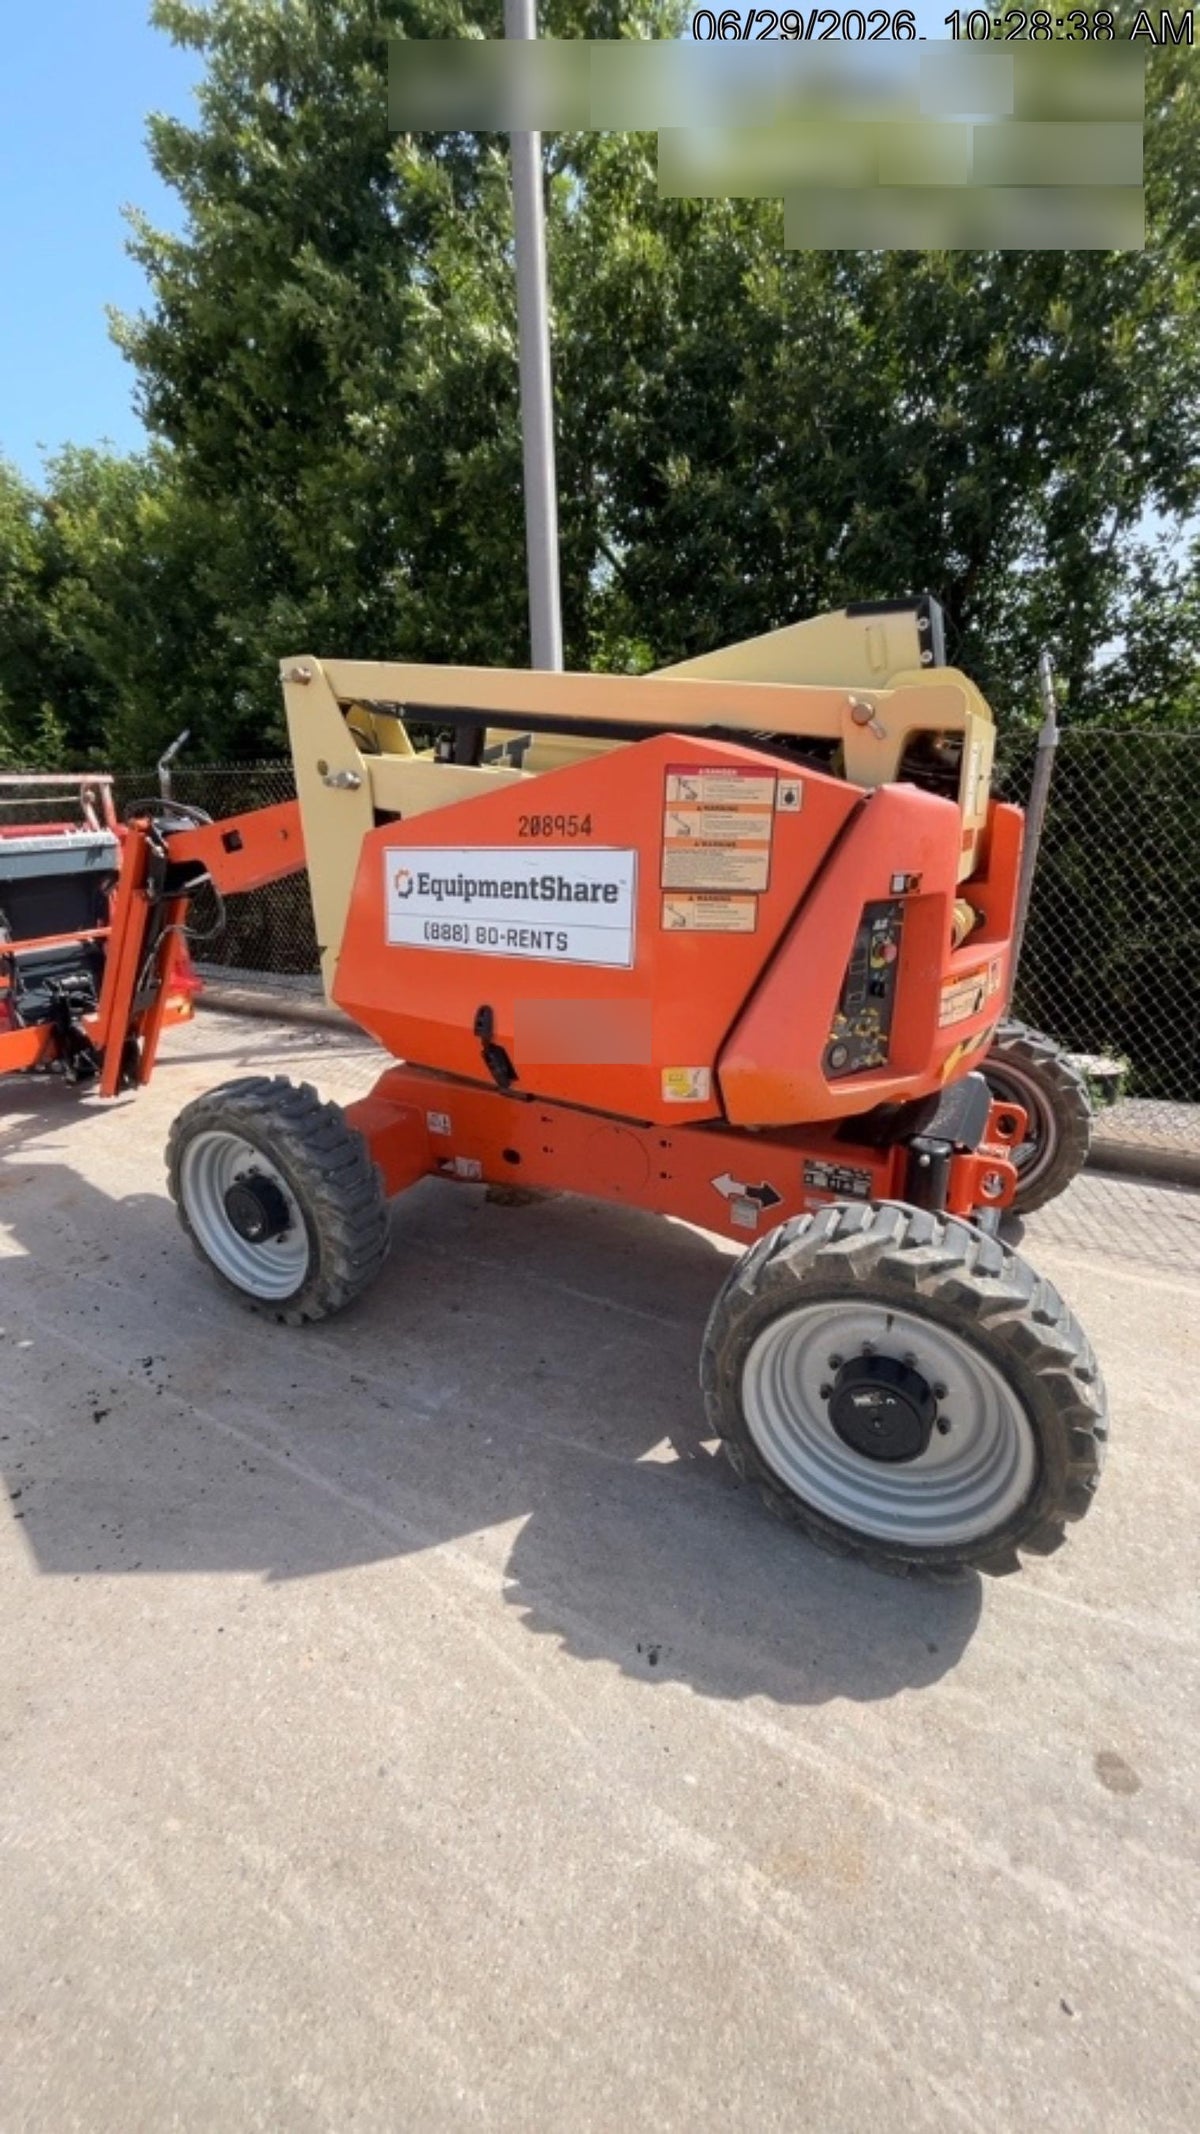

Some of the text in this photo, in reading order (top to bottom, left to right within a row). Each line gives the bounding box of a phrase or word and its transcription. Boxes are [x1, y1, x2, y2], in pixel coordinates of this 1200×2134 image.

[518, 814, 593, 838] 208954
[417, 872, 618, 904] EquipmentShare
[424, 921, 469, 944] (888)
